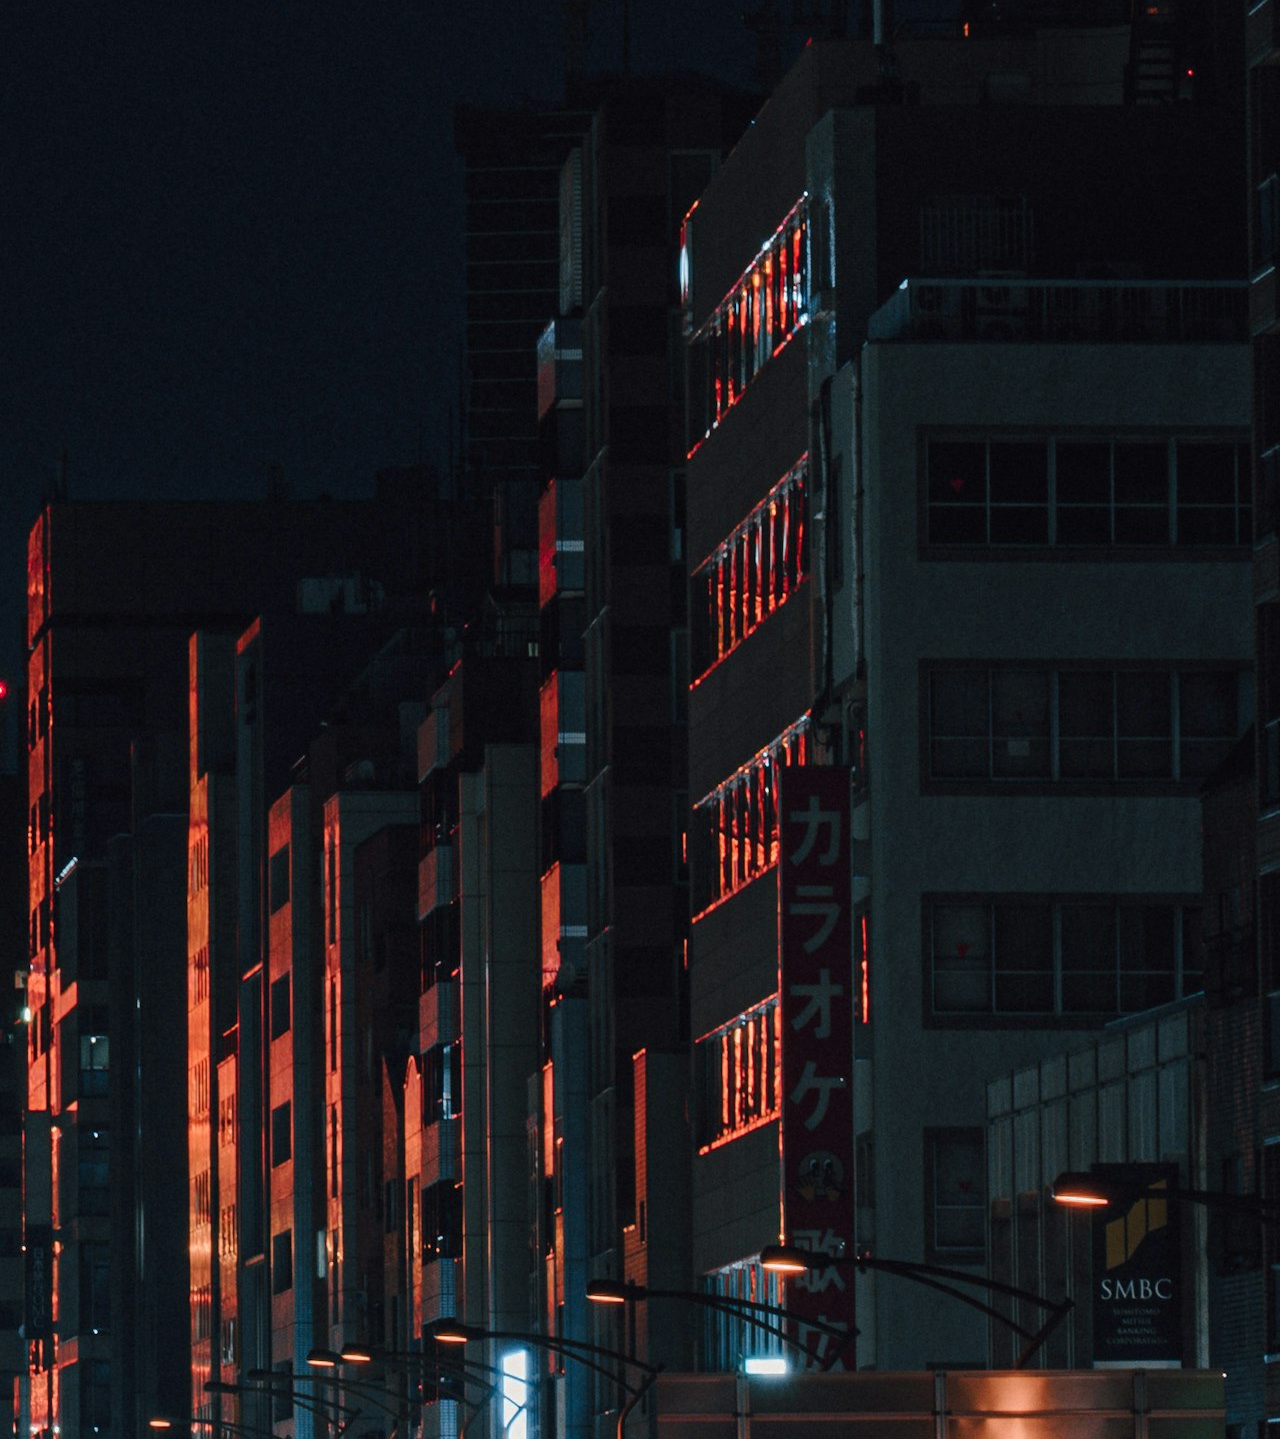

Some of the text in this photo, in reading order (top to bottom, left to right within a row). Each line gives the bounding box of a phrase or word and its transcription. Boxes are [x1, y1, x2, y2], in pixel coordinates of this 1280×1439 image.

[789, 795, 847, 1131] カラオケ
[1100, 1278, 1172, 1300] SMBC
